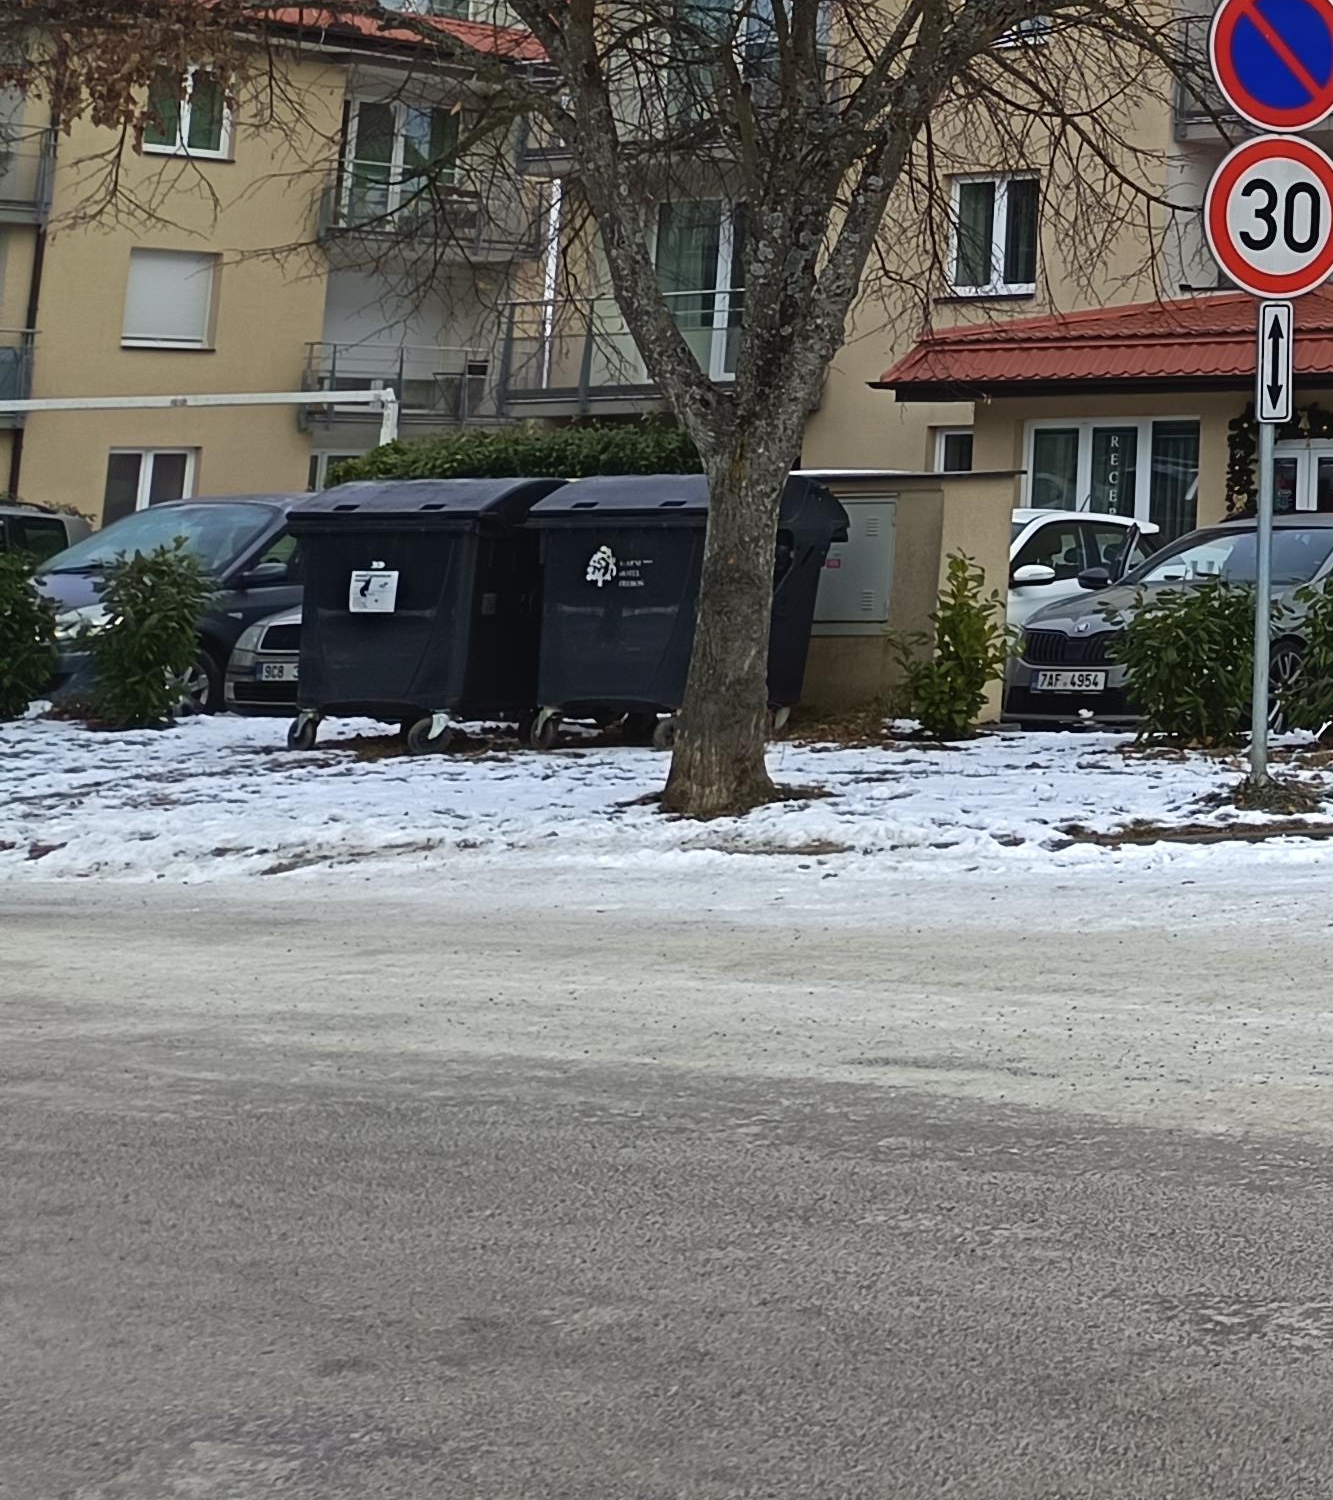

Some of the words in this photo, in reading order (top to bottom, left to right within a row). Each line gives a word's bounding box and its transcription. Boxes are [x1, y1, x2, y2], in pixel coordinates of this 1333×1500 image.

[1239, 178, 1320, 253] 30
[1040, 673, 1062, 688] 7AF
[1069, 673, 1099, 688] 4954
